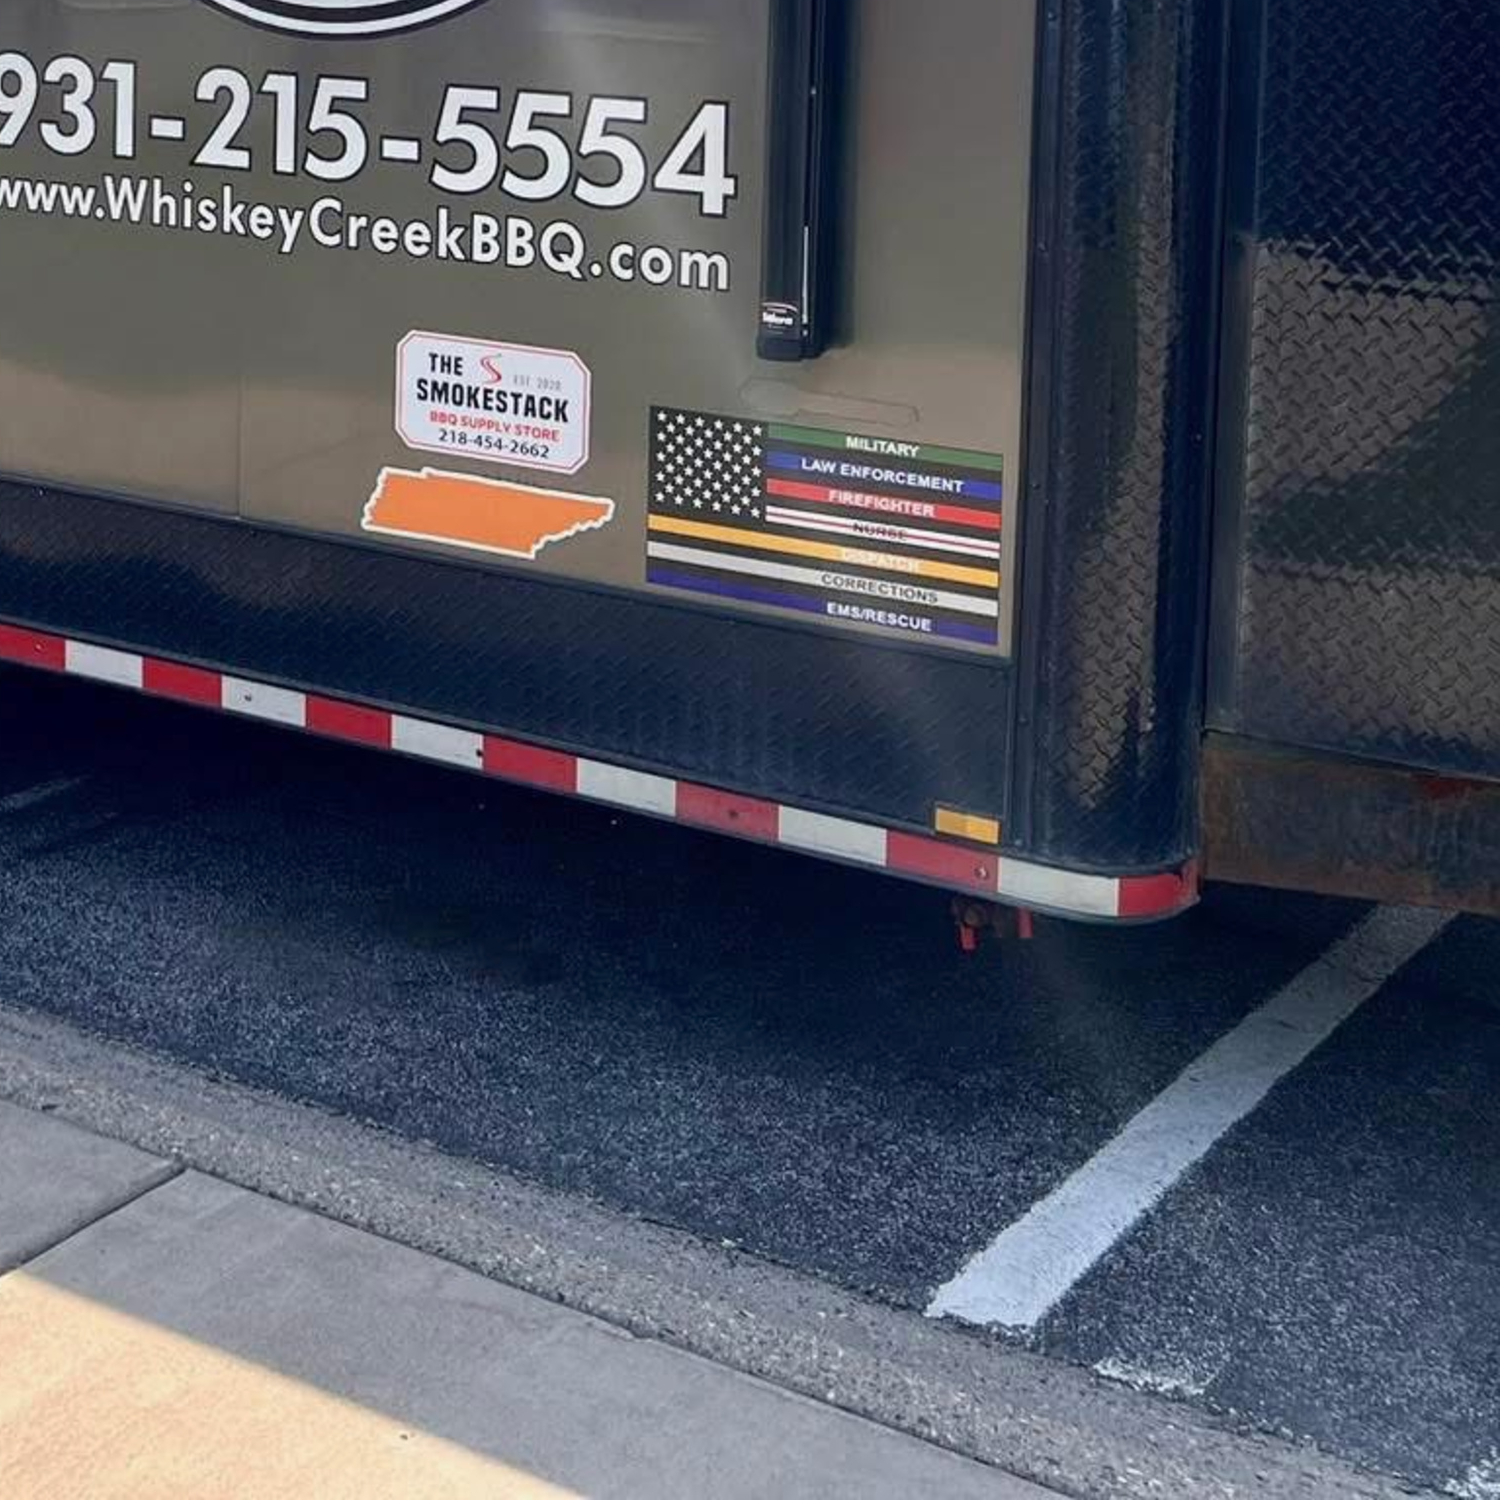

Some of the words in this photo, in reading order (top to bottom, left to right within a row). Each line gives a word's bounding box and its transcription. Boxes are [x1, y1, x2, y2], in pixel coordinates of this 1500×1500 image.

[428, 352, 464, 377] THE
[416, 378, 569, 423] SMOKESTACK
[429, 410, 457, 426] BBQ
[459, 414, 512, 433] SUPPLY
[514, 423, 560, 442] STORE
[438, 428, 550, 460] 218-454-2662
[846, 435, 920, 458] MILITARY
[801, 458, 837, 475] LAW
[840, 462, 965, 494] ENFORCEMENT
[828, 489, 936, 517] FIREFIGHTER
[821, 572, 938, 603] CORRECTIONS
[827, 601, 932, 632] EMS/RESCUE
